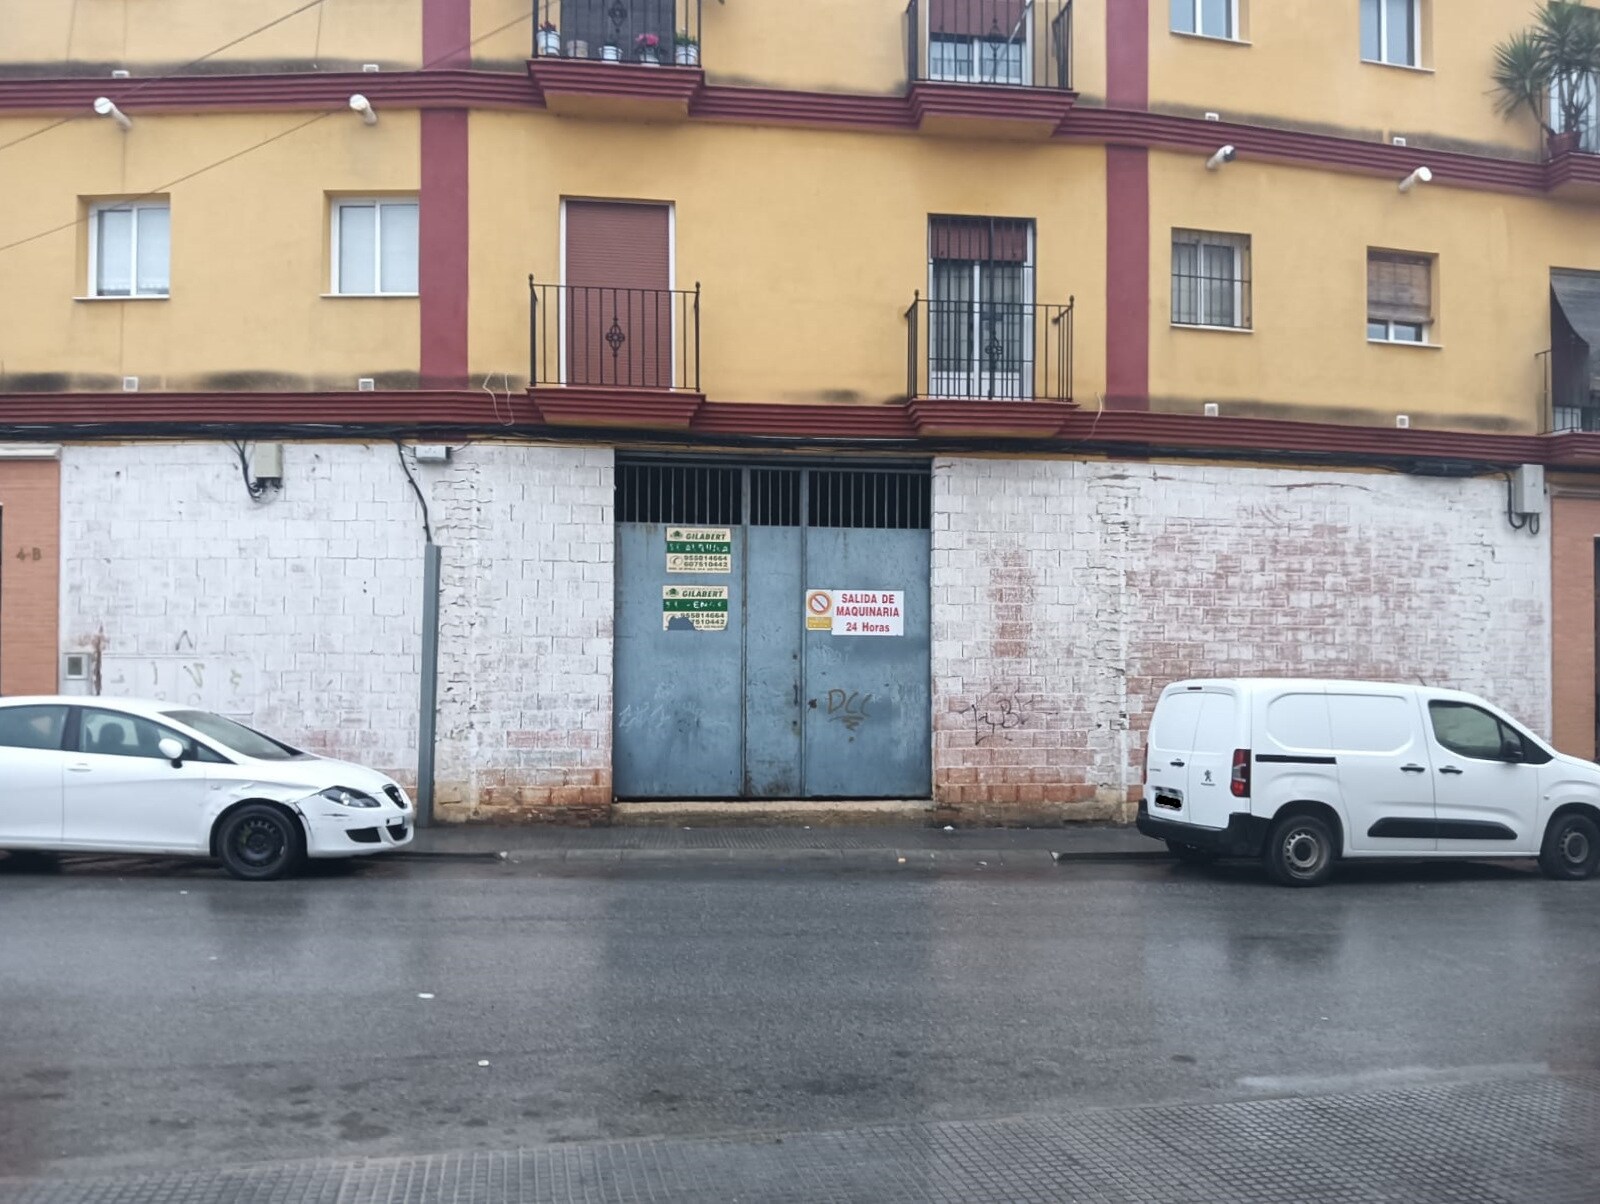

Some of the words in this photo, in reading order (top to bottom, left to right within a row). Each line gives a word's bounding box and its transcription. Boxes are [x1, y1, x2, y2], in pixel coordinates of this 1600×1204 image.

[685, 532, 726, 540] GILABERT
[682, 590, 724, 598] GILABERT
[841, 593, 878, 604] SALIDA
[881, 594, 895, 604] DE
[836, 606, 900, 617] MAQUINARIA
[845, 622, 857, 632] 24
[862, 622, 890, 632] Horas
